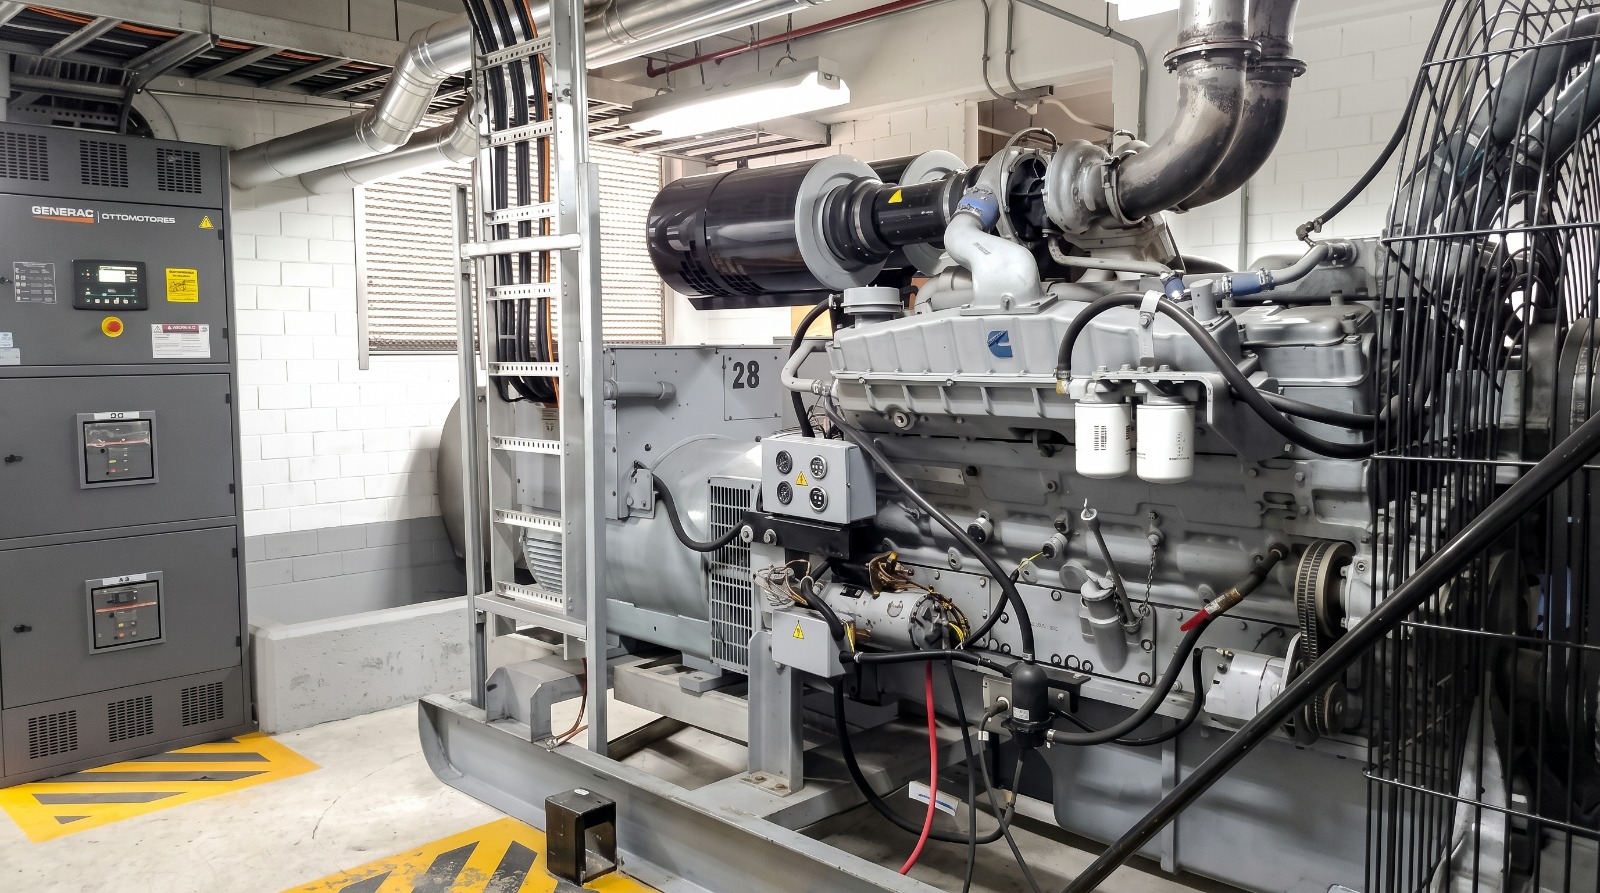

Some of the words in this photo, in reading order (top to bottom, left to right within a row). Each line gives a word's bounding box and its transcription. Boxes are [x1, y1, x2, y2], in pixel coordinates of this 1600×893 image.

[32, 206, 94, 218] GENERAC
[101, 213, 176, 224] OTTOMOTORES
[732, 360, 760, 390] 28
